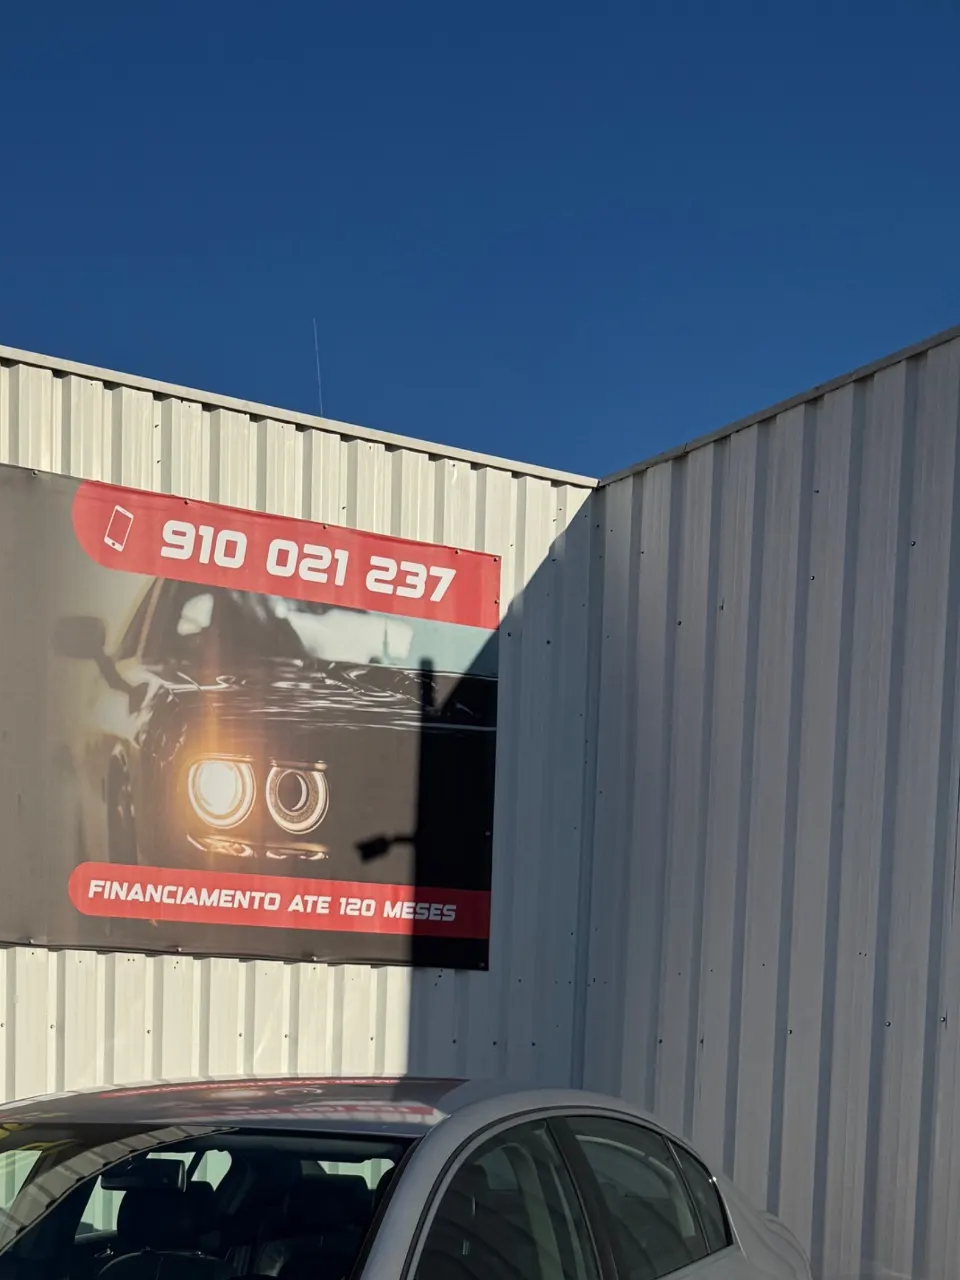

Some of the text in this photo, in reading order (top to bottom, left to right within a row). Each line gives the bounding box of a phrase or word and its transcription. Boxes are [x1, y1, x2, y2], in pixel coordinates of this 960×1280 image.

[160, 519, 456, 602] 910 021 237
[88, 879, 457, 922] FINANCIAMENTO ATE 120 MESES
